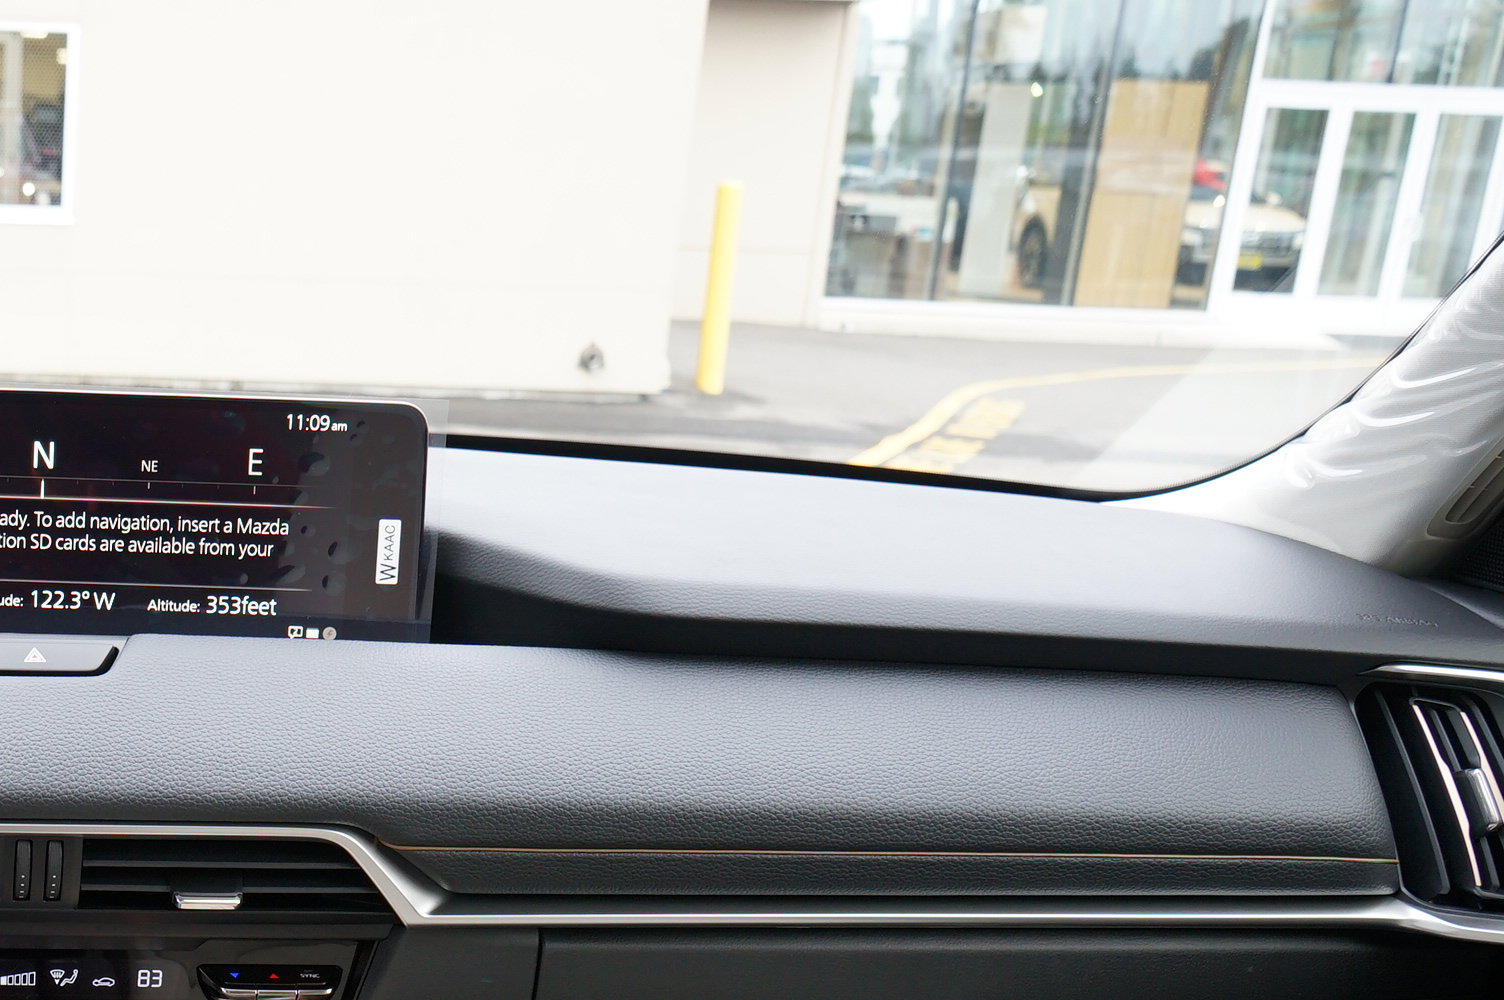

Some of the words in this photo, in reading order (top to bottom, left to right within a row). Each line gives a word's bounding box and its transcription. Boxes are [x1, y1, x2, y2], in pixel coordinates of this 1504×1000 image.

[32, 441, 55, 469] N
[141, 460, 158, 472] NE
[248, 448, 263, 476] E
[34, 511, 52, 528] To
[56, 511, 86, 529] add
[90, 515, 173, 534] navigation,
[178, 516, 220, 533] insert
[223, 520, 232, 533] a
[236, 518, 289, 535] Mazda
[30, 534, 52, 550] SD
[55, 534, 96, 551] cards
[100, 539, 124, 552] are
[128, 537, 195, 554] available
[199, 538, 234, 555] from
[238, 543, 274, 560] your
[31, 590, 90, 609] 122.3°
[94, 592, 115, 610] W
[147, 599, 200, 613] Altitude:
[206, 596, 277, 616] 353feet
[137, 969, 163, 987] 83
